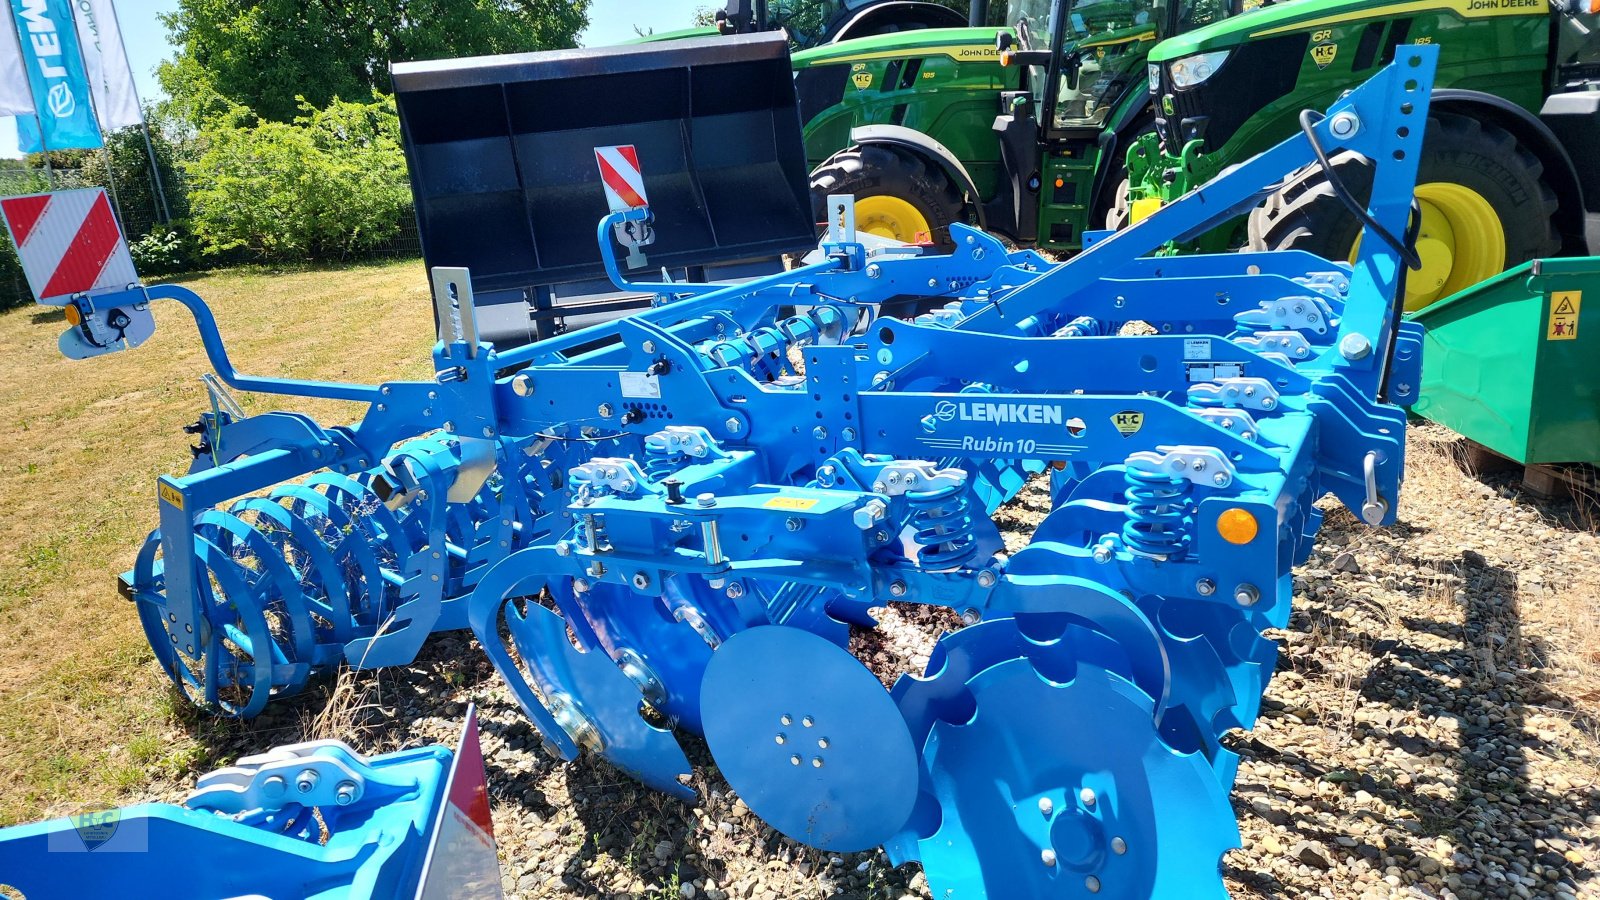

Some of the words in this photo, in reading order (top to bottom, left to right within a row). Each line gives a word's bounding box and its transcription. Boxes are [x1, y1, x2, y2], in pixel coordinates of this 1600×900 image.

[1467, 0, 1498, 10] JOHN
[1502, 0, 1540, 8] DEERE
[1312, 29, 1332, 42] 6R
[1414, 36, 1432, 46] 185
[958, 48, 982, 56] JOHN
[852, 63, 866, 72] 6R
[958, 402, 1063, 427] LEMKEN
[961, 436, 1014, 454] Rubin
[1016, 438, 1036, 454] 10
